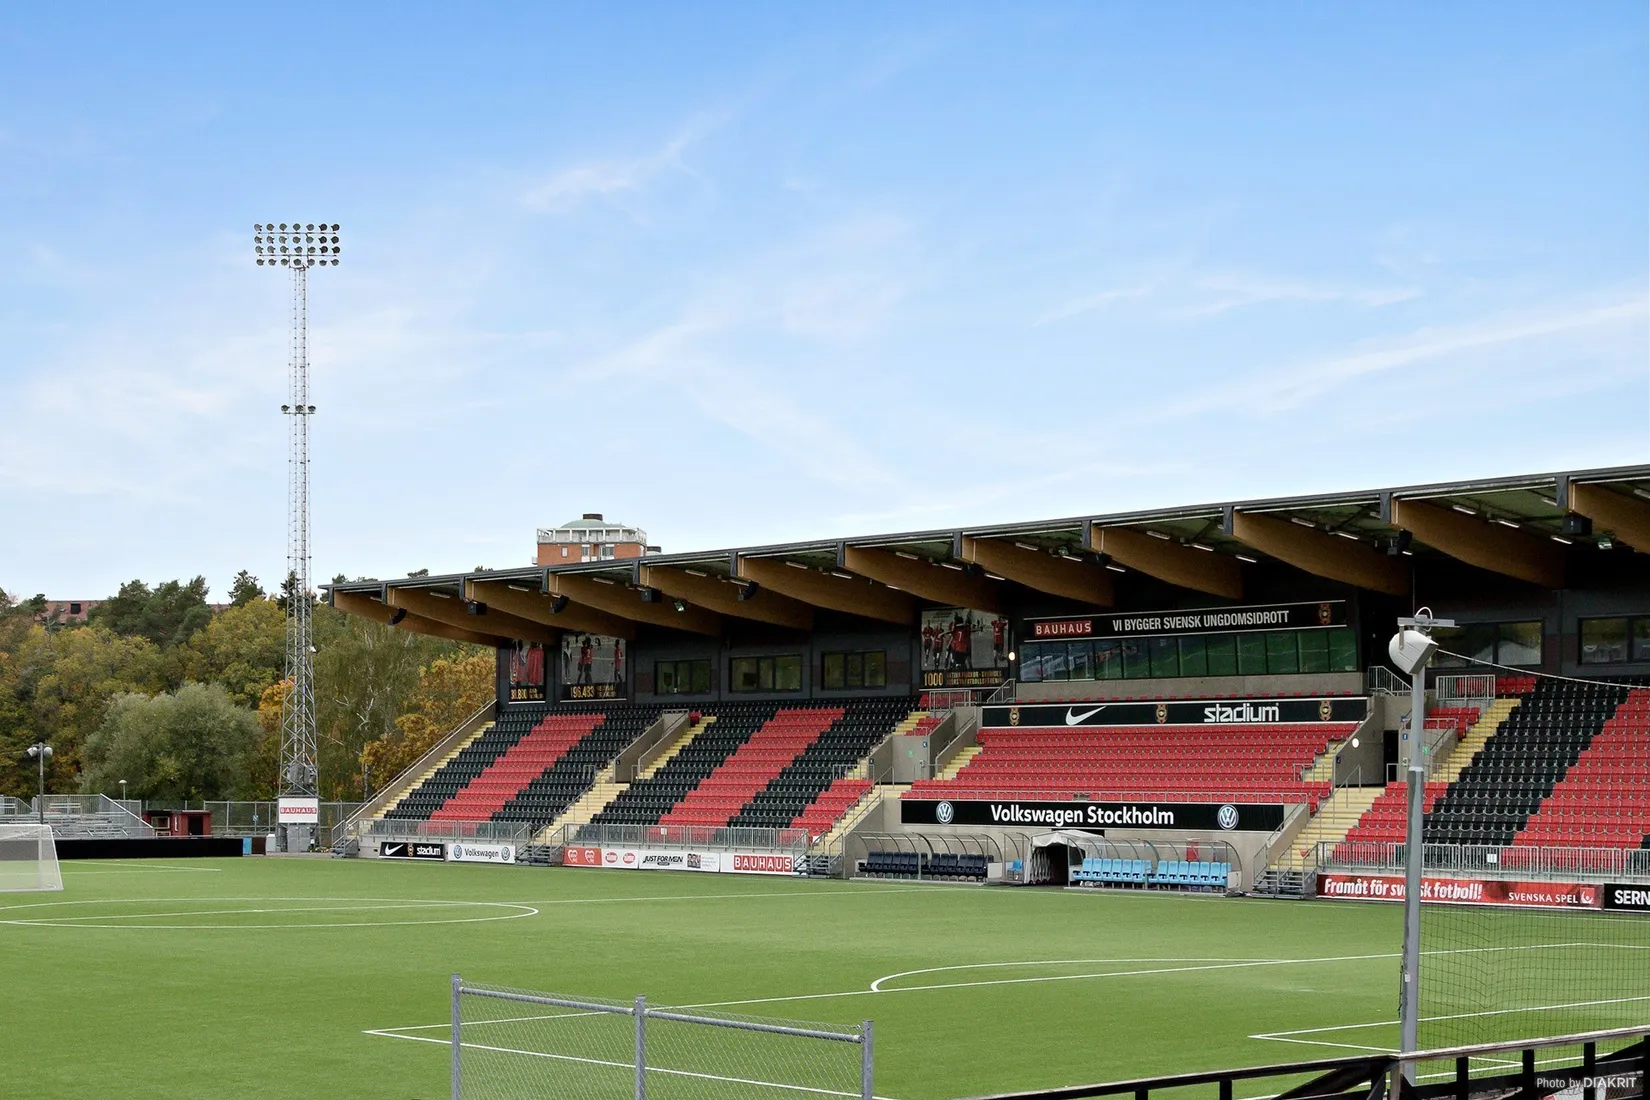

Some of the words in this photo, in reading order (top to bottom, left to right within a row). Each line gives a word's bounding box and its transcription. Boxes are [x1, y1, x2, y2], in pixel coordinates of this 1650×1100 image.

[1035, 623, 1091, 635] BAUHAUS
[1112, 619, 1122, 631] VI
[1125, 618, 1161, 631] BYGGER
[1163, 615, 1202, 629] SVENSK
[1203, 610, 1289, 627] UNGDOMSIDROTT
[924, 672, 944, 686] 1000
[1203, 702, 1279, 723] stadium
[280, 806, 317, 815] BAUHAUS
[990, 804, 1083, 827] Volkswagen
[1087, 805, 1174, 825] Stockholm
[416, 845, 441, 856] stadium
[464, 848, 499, 859] Volkswagen
[642, 855, 657, 864] JUST
[734, 855, 792, 871] BAUHAUS
[1324, 878, 1369, 895] Framåt
[1369, 879, 1389, 896] för
[1390, 882, 1432, 898] svsk
[1433, 882, 1483, 900] fotboll!
[1508, 892, 1553, 903] SVENSKA
[1555, 894, 1579, 904] SPEL
